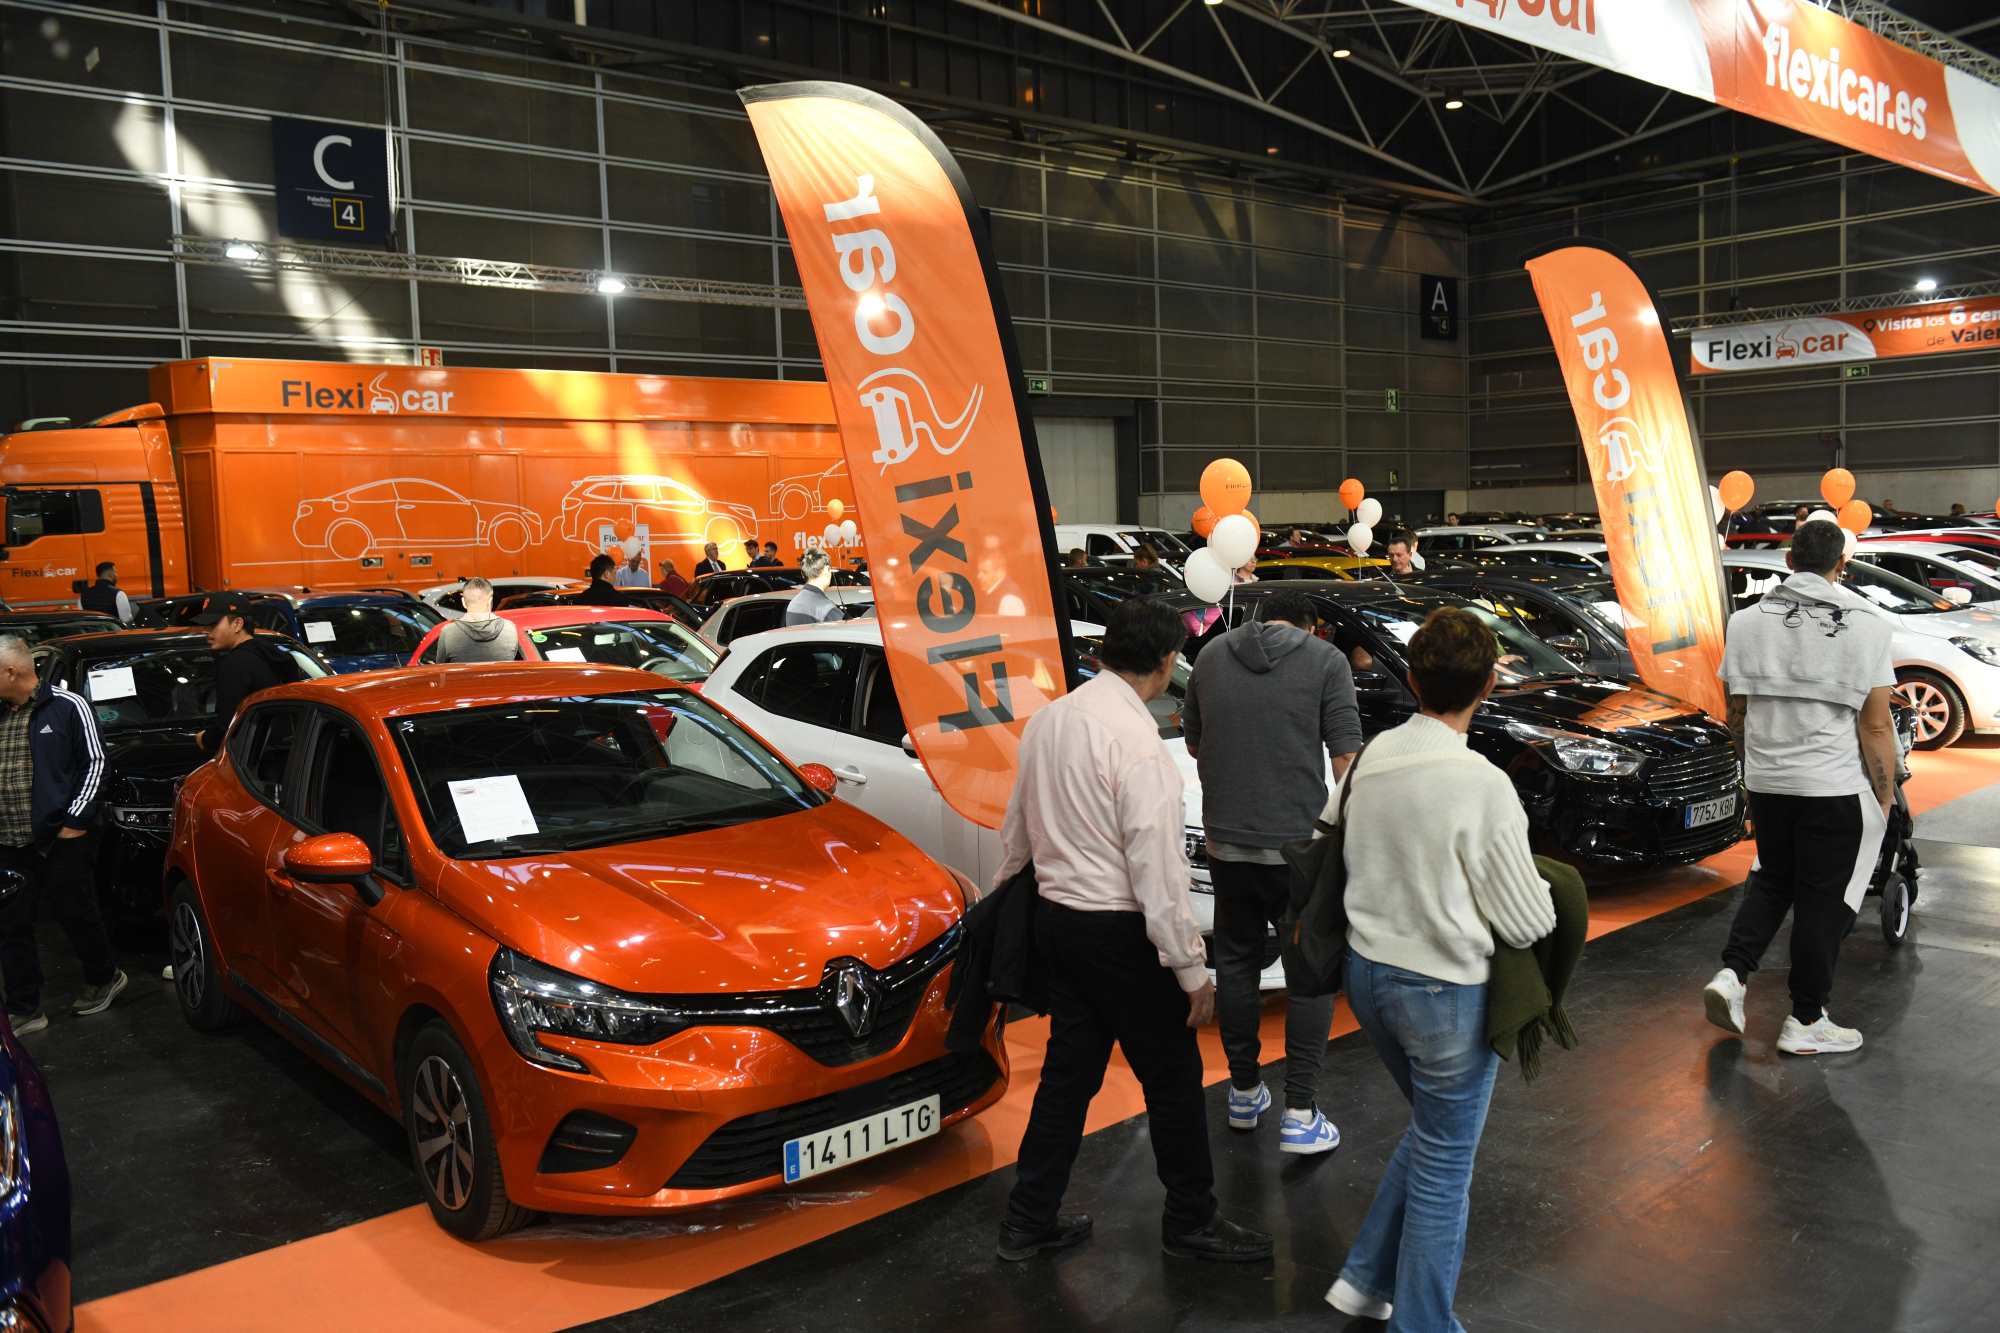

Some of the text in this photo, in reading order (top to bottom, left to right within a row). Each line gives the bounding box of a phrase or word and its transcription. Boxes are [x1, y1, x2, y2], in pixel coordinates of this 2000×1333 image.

[1762, 21, 1928, 141] flexicar.es
[313, 134, 355, 190] C
[341, 204, 356, 224] 4
[1431, 281, 1448, 311] A
[1877, 316, 1923, 333] Visita
[1926, 315, 1946, 328] los
[1949, 304, 1967, 325] 6
[1708, 331, 1849, 362] Flexi car
[1926, 335, 1945, 346] de
[281, 380, 454, 411] Flexi car
[56, 567, 78, 576] car
[1692, 802, 1718, 825] 7752
[806, 1104, 931, 1170] 1411 LTG
[790, 1164, 796, 1174] E
